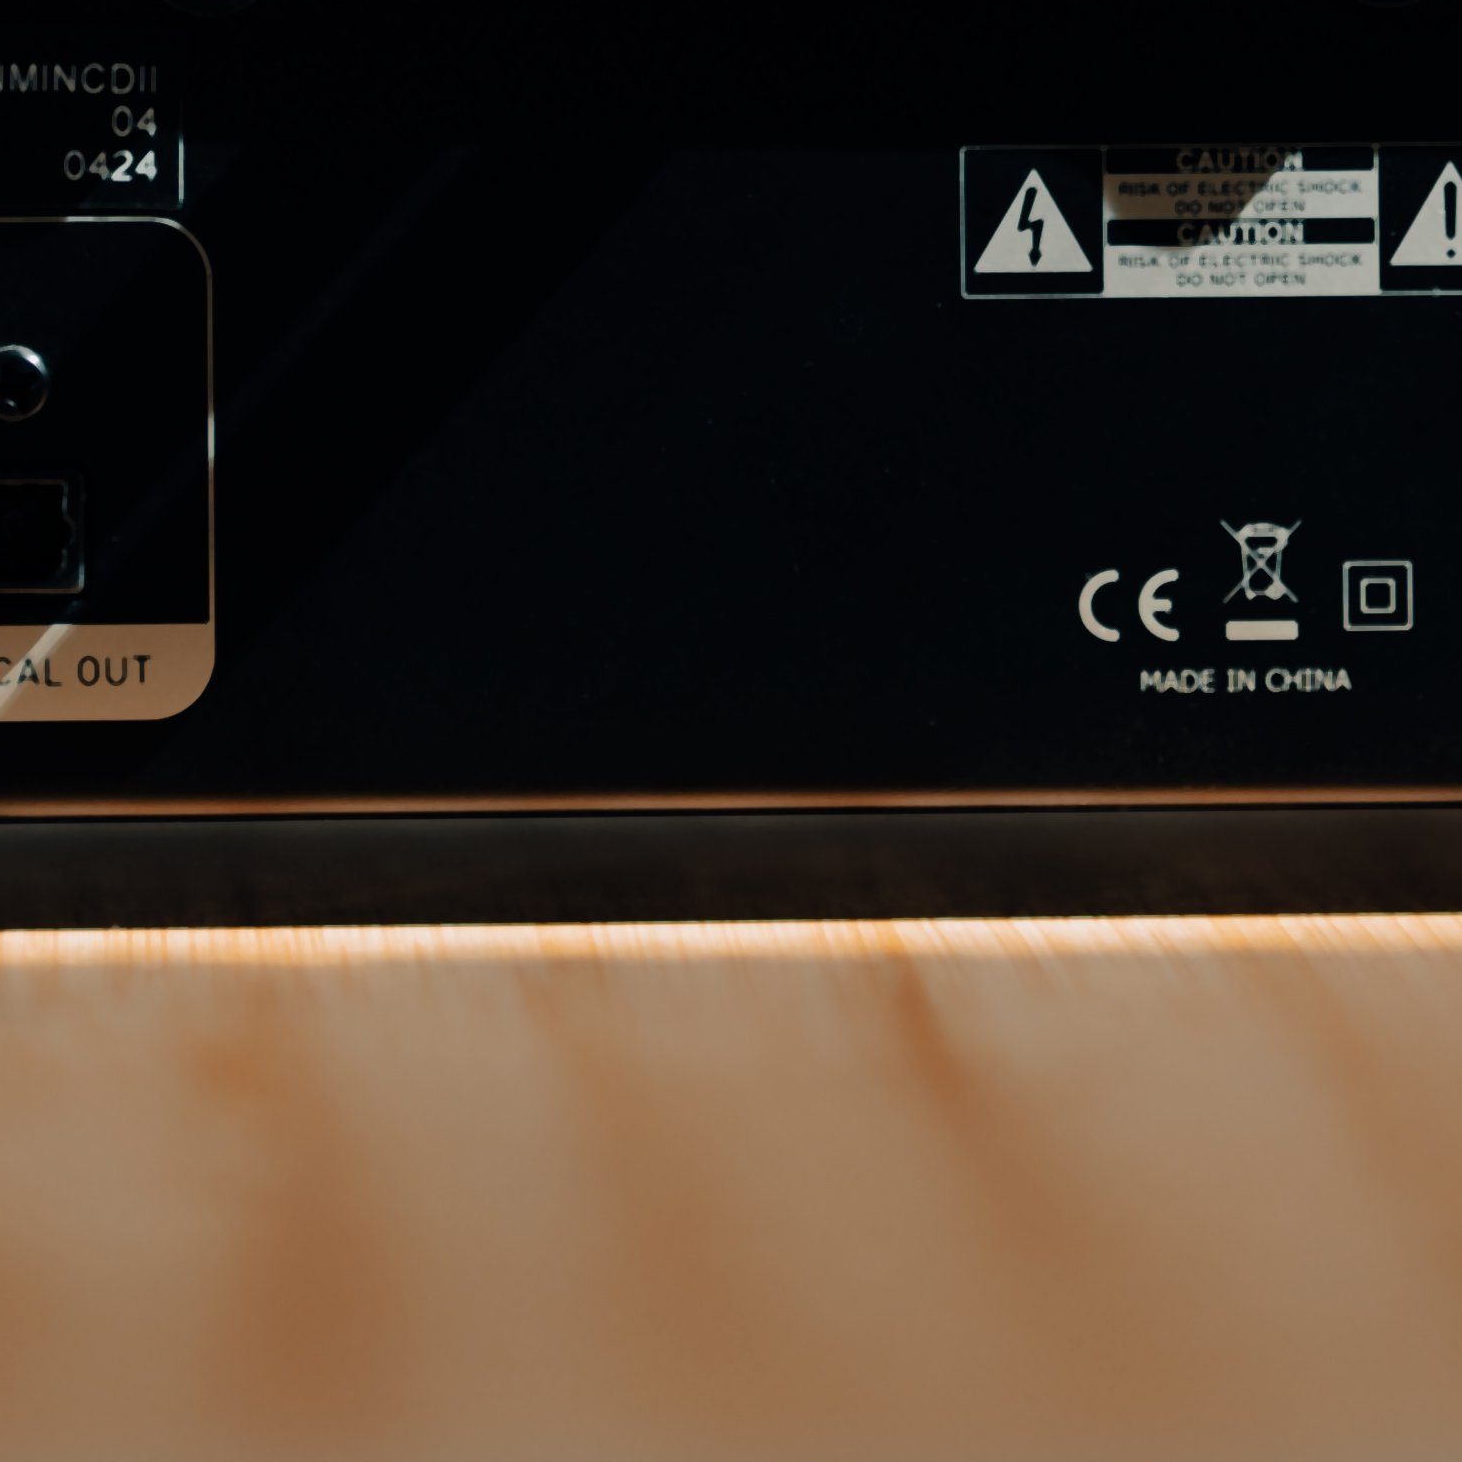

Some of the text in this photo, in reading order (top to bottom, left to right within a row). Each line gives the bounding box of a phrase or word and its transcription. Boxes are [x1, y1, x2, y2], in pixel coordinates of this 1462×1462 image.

[111, 105, 158, 138] 04
[63, 149, 158, 183] 0424
[1176, 148, 1303, 172] CAUTION
[1176, 222, 1303, 245] CAUTION
[1077, 568, 1181, 643] CE
[77, 656, 151, 686] OUT
[1139, 667, 1353, 694] MADE IN CHINA
